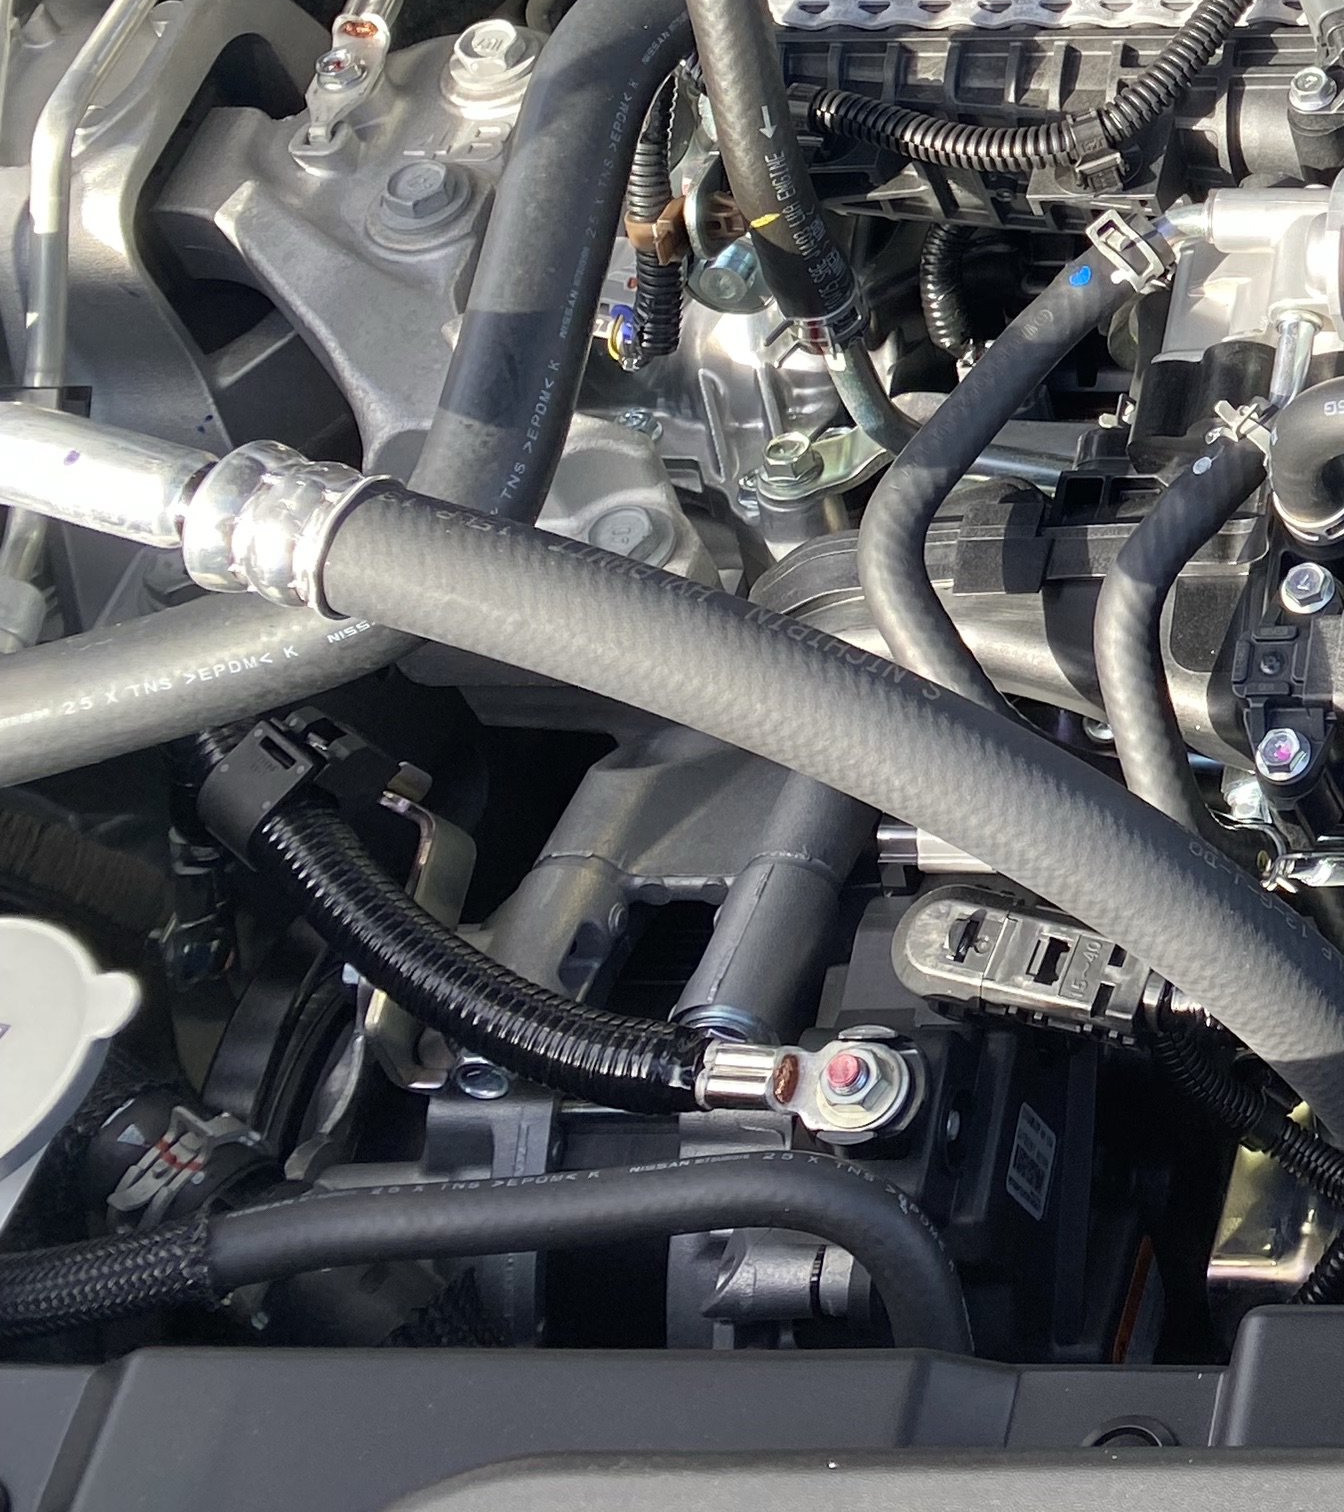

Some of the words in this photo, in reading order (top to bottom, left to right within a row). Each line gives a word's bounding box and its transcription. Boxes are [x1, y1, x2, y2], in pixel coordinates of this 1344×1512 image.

[765, 149, 796, 201] ENGINE
[500, 461, 528, 501] TNS
[523, 379, 557, 455] >EPDM<
[547, 358, 562, 372] K
[560, 289, 580, 340] NISSAN
[608, 94, 633, 153] >EPDM<
[62, 698, 95, 716] 25
[104, 688, 120, 705] X
[128, 677, 173, 698] TNS
[184, 653, 274, 686] >EPDM<
[282, 644, 299, 659] K
[326, 618, 376, 644] NISS
[629, 1158, 690, 1173] NISSAN
[806, 1153, 820, 1165] X
[834, 1159, 876, 1183] TNS
